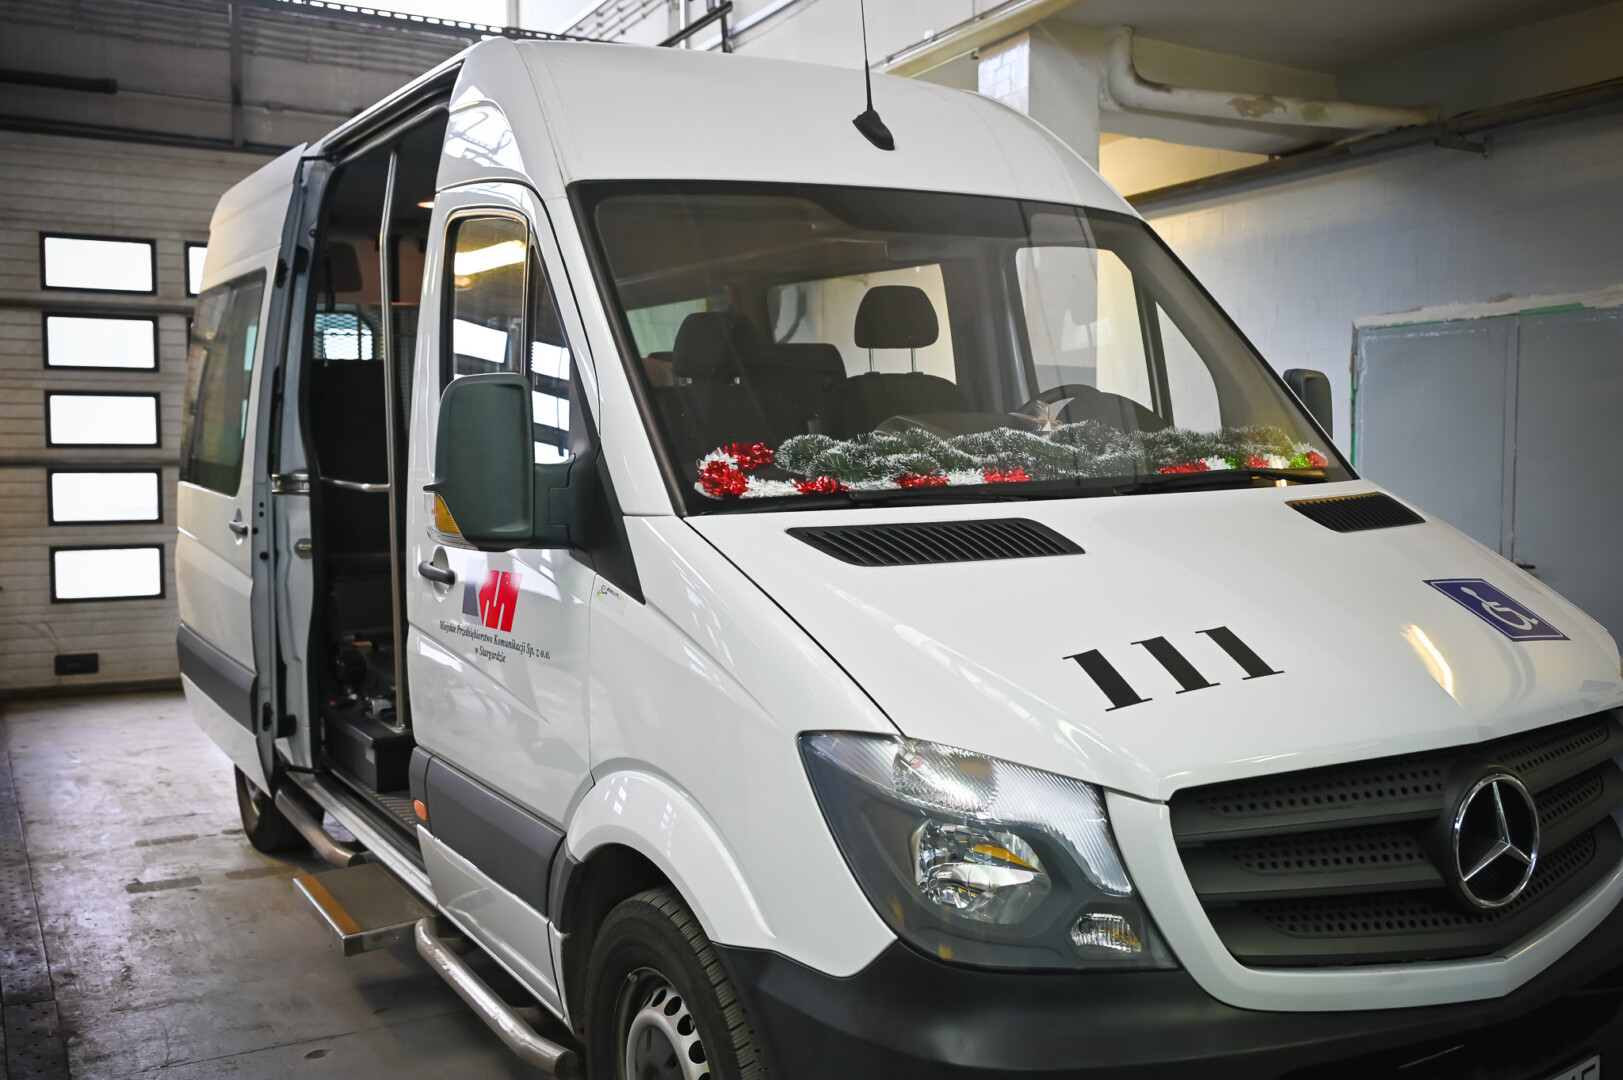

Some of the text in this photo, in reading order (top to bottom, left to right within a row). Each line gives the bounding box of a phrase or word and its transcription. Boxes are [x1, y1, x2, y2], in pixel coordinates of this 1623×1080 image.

[440, 620, 456, 633] Miejskie
[493, 635, 525, 654] Komunikacji
[526, 643, 534, 657] Sp.
[535, 648, 540, 658] z
[540, 650, 550, 659] o.o.
[479, 646, 506, 662] Stargardzie
[1062, 625, 1285, 712] 111
